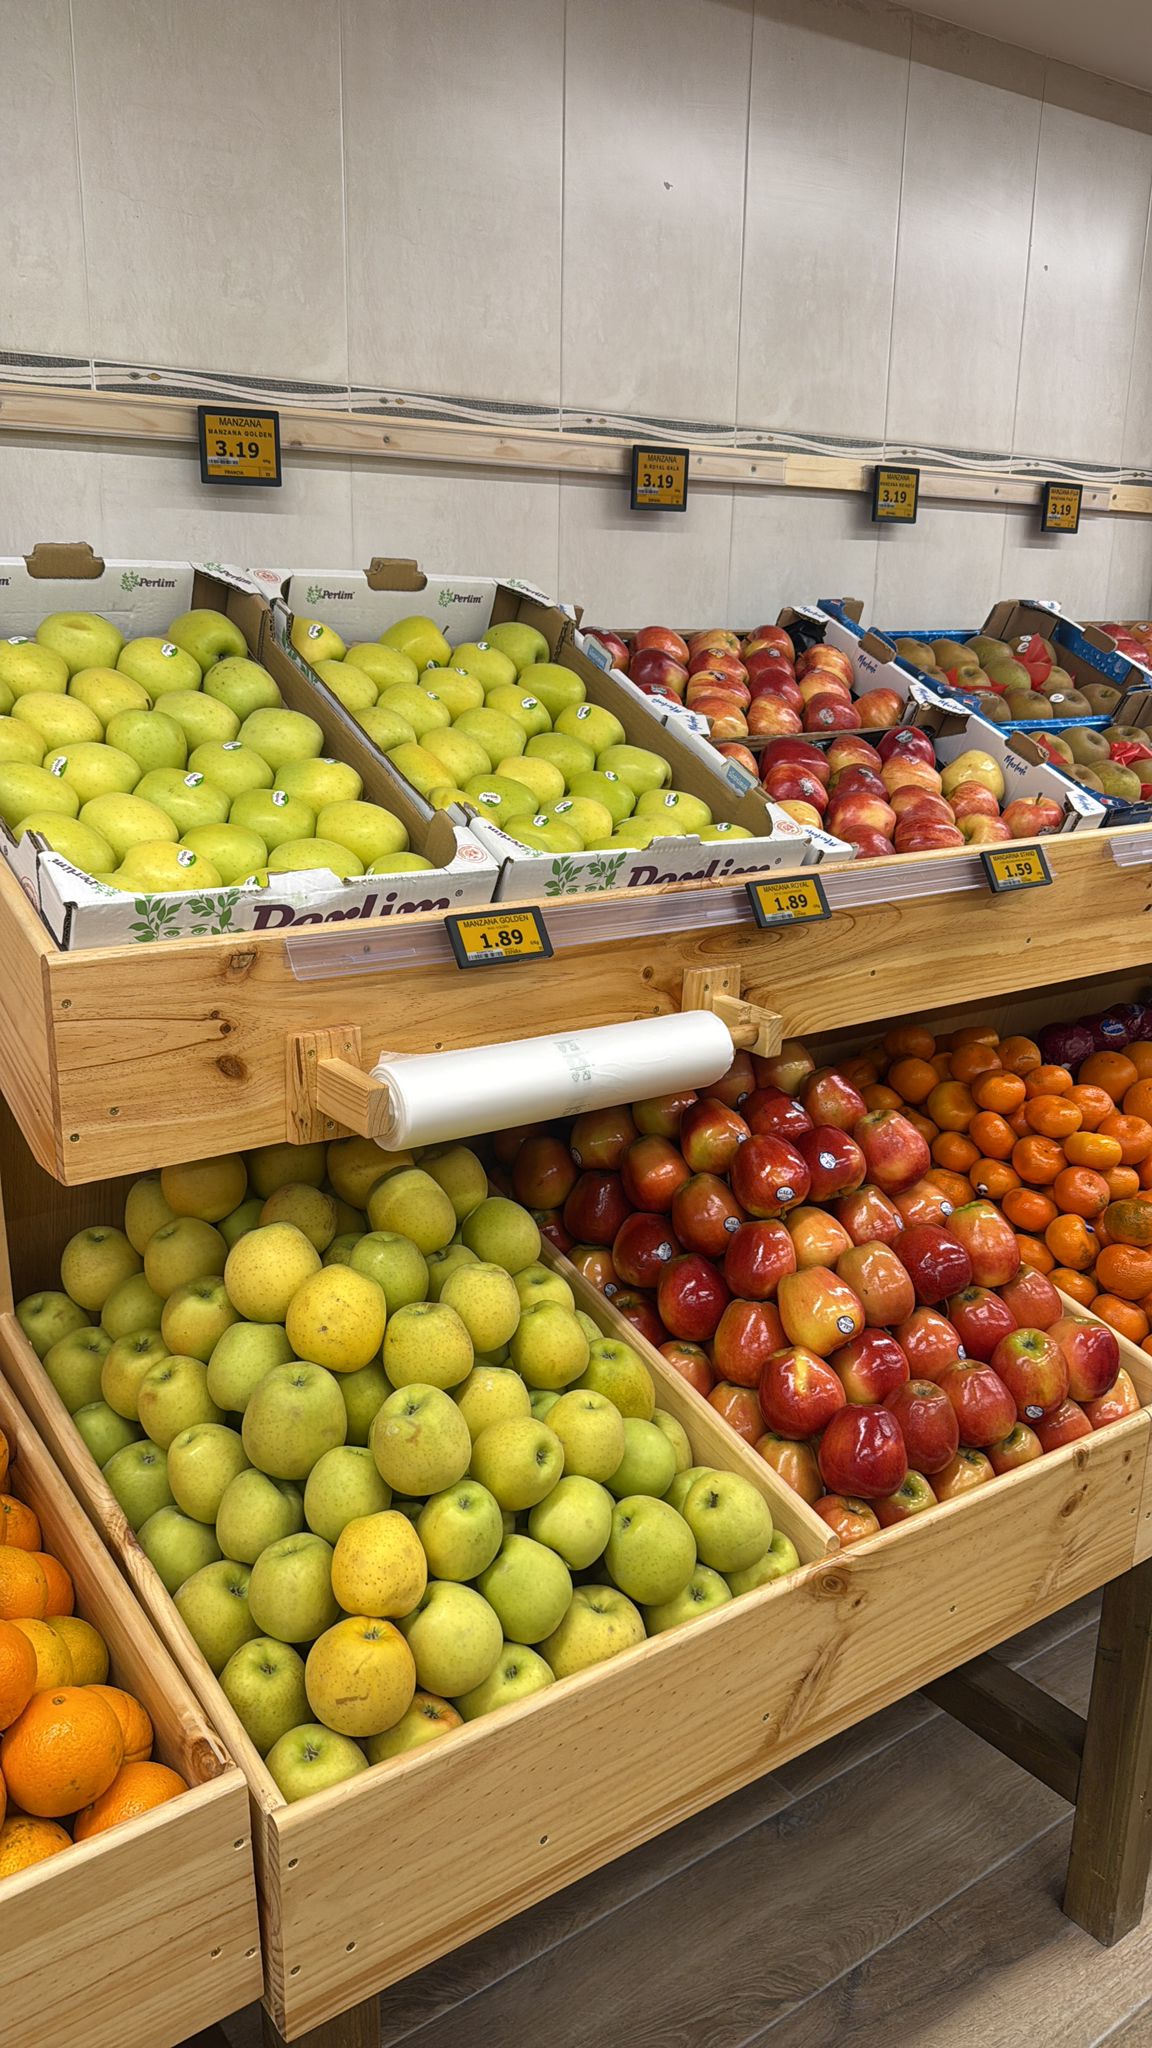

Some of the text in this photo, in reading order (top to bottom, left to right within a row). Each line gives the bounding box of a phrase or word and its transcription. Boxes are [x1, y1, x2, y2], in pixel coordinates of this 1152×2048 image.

[219, 417, 262, 428] MANZANA
[216, 440, 260, 458] 3.19
[648, 454, 678, 464] MANZANA
[643, 474, 674, 489] 3.19
[882, 490, 906, 504] 3.19
[1050, 504, 1072, 516] 3.19
[139, 578, 176, 588] Perlim
[322, 590, 354, 600] Perlim
[452, 594, 482, 604] Perlim
[1004, 862, 1032, 878] 1.59
[763, 884, 790, 892] MANZANA
[774, 894, 808, 911] 1.89
[462, 918, 498, 928] MANZANA
[500, 914, 529, 924] GOLDEN
[480, 929, 524, 948] 1.89
